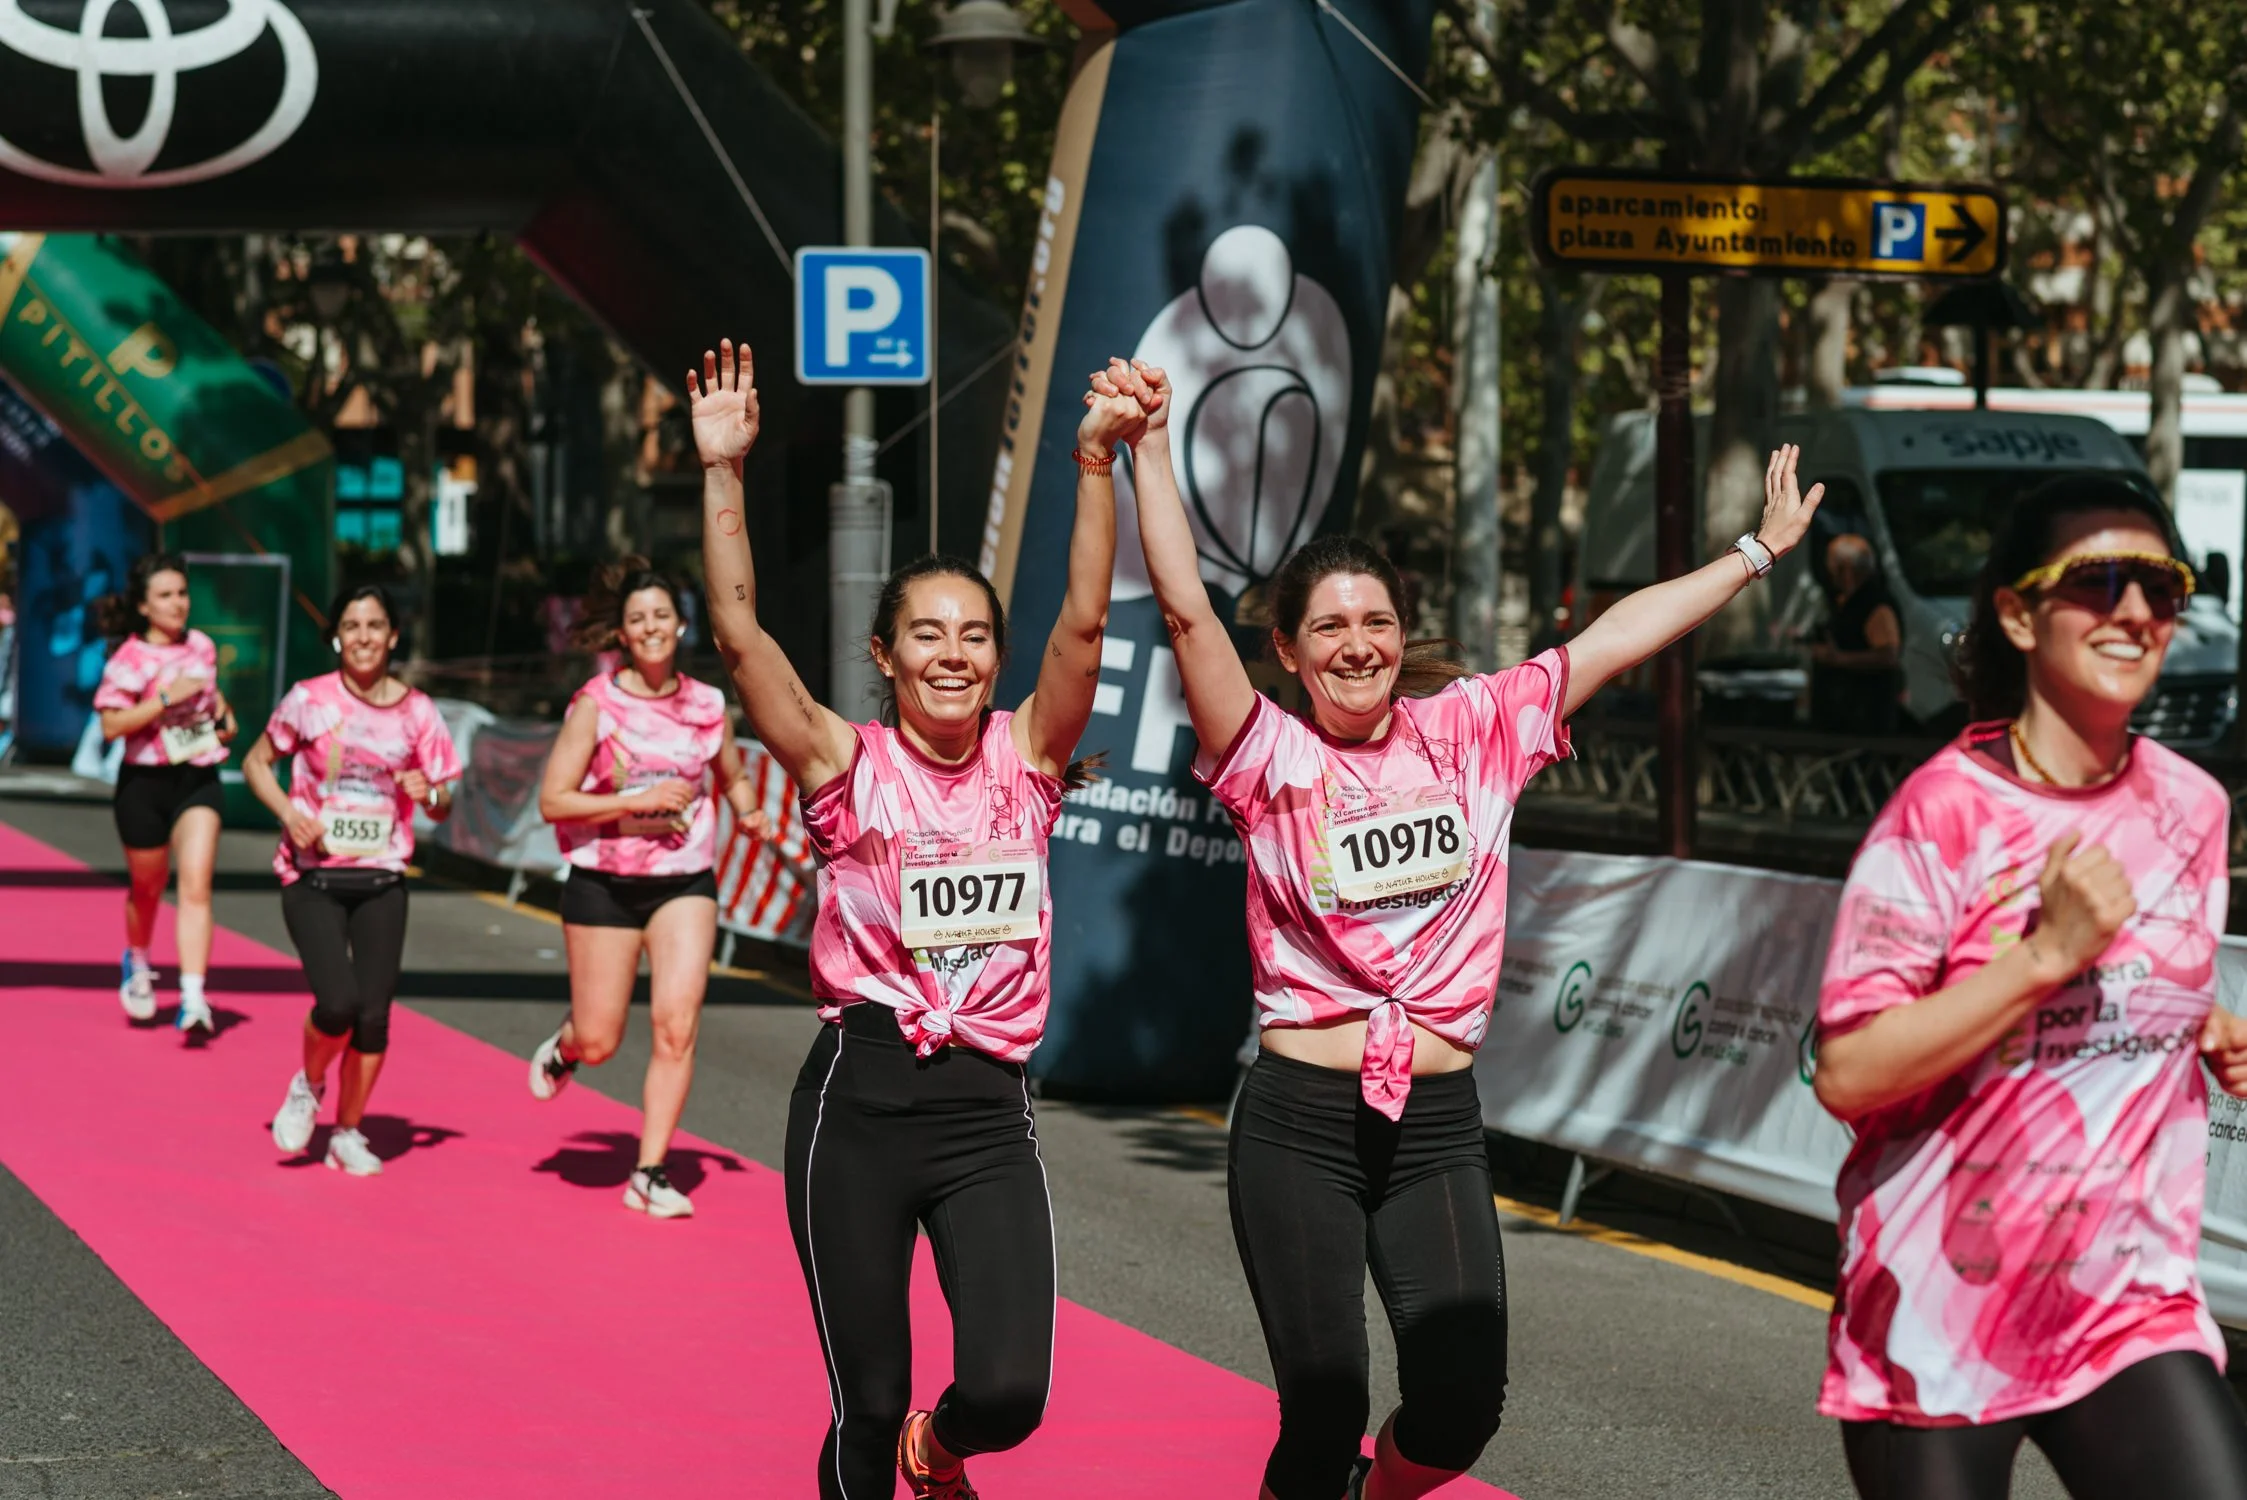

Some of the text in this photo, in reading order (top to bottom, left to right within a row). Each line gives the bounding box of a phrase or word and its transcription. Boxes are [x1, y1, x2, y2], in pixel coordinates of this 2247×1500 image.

[1558, 193, 1768, 223] aparcamiento:
[1557, 225, 1857, 258] plaza Ayuntamiento
[1877, 205, 1918, 258] P
[824, 264, 902, 368] P
[18, 299, 185, 483] PITILLOS
[1060, 776, 1198, 823] ndación
[332, 818, 381, 841] 8553
[1116, 822, 1150, 853] el
[1339, 814, 1460, 873] 10978
[909, 872, 1026, 918] 10977
[1385, 877, 1414, 890] NATUR
[1415, 871, 1441, 883] HOUSE
[2036, 997, 2120, 1036] por la
[2208, 1117, 2247, 1143] cánce
